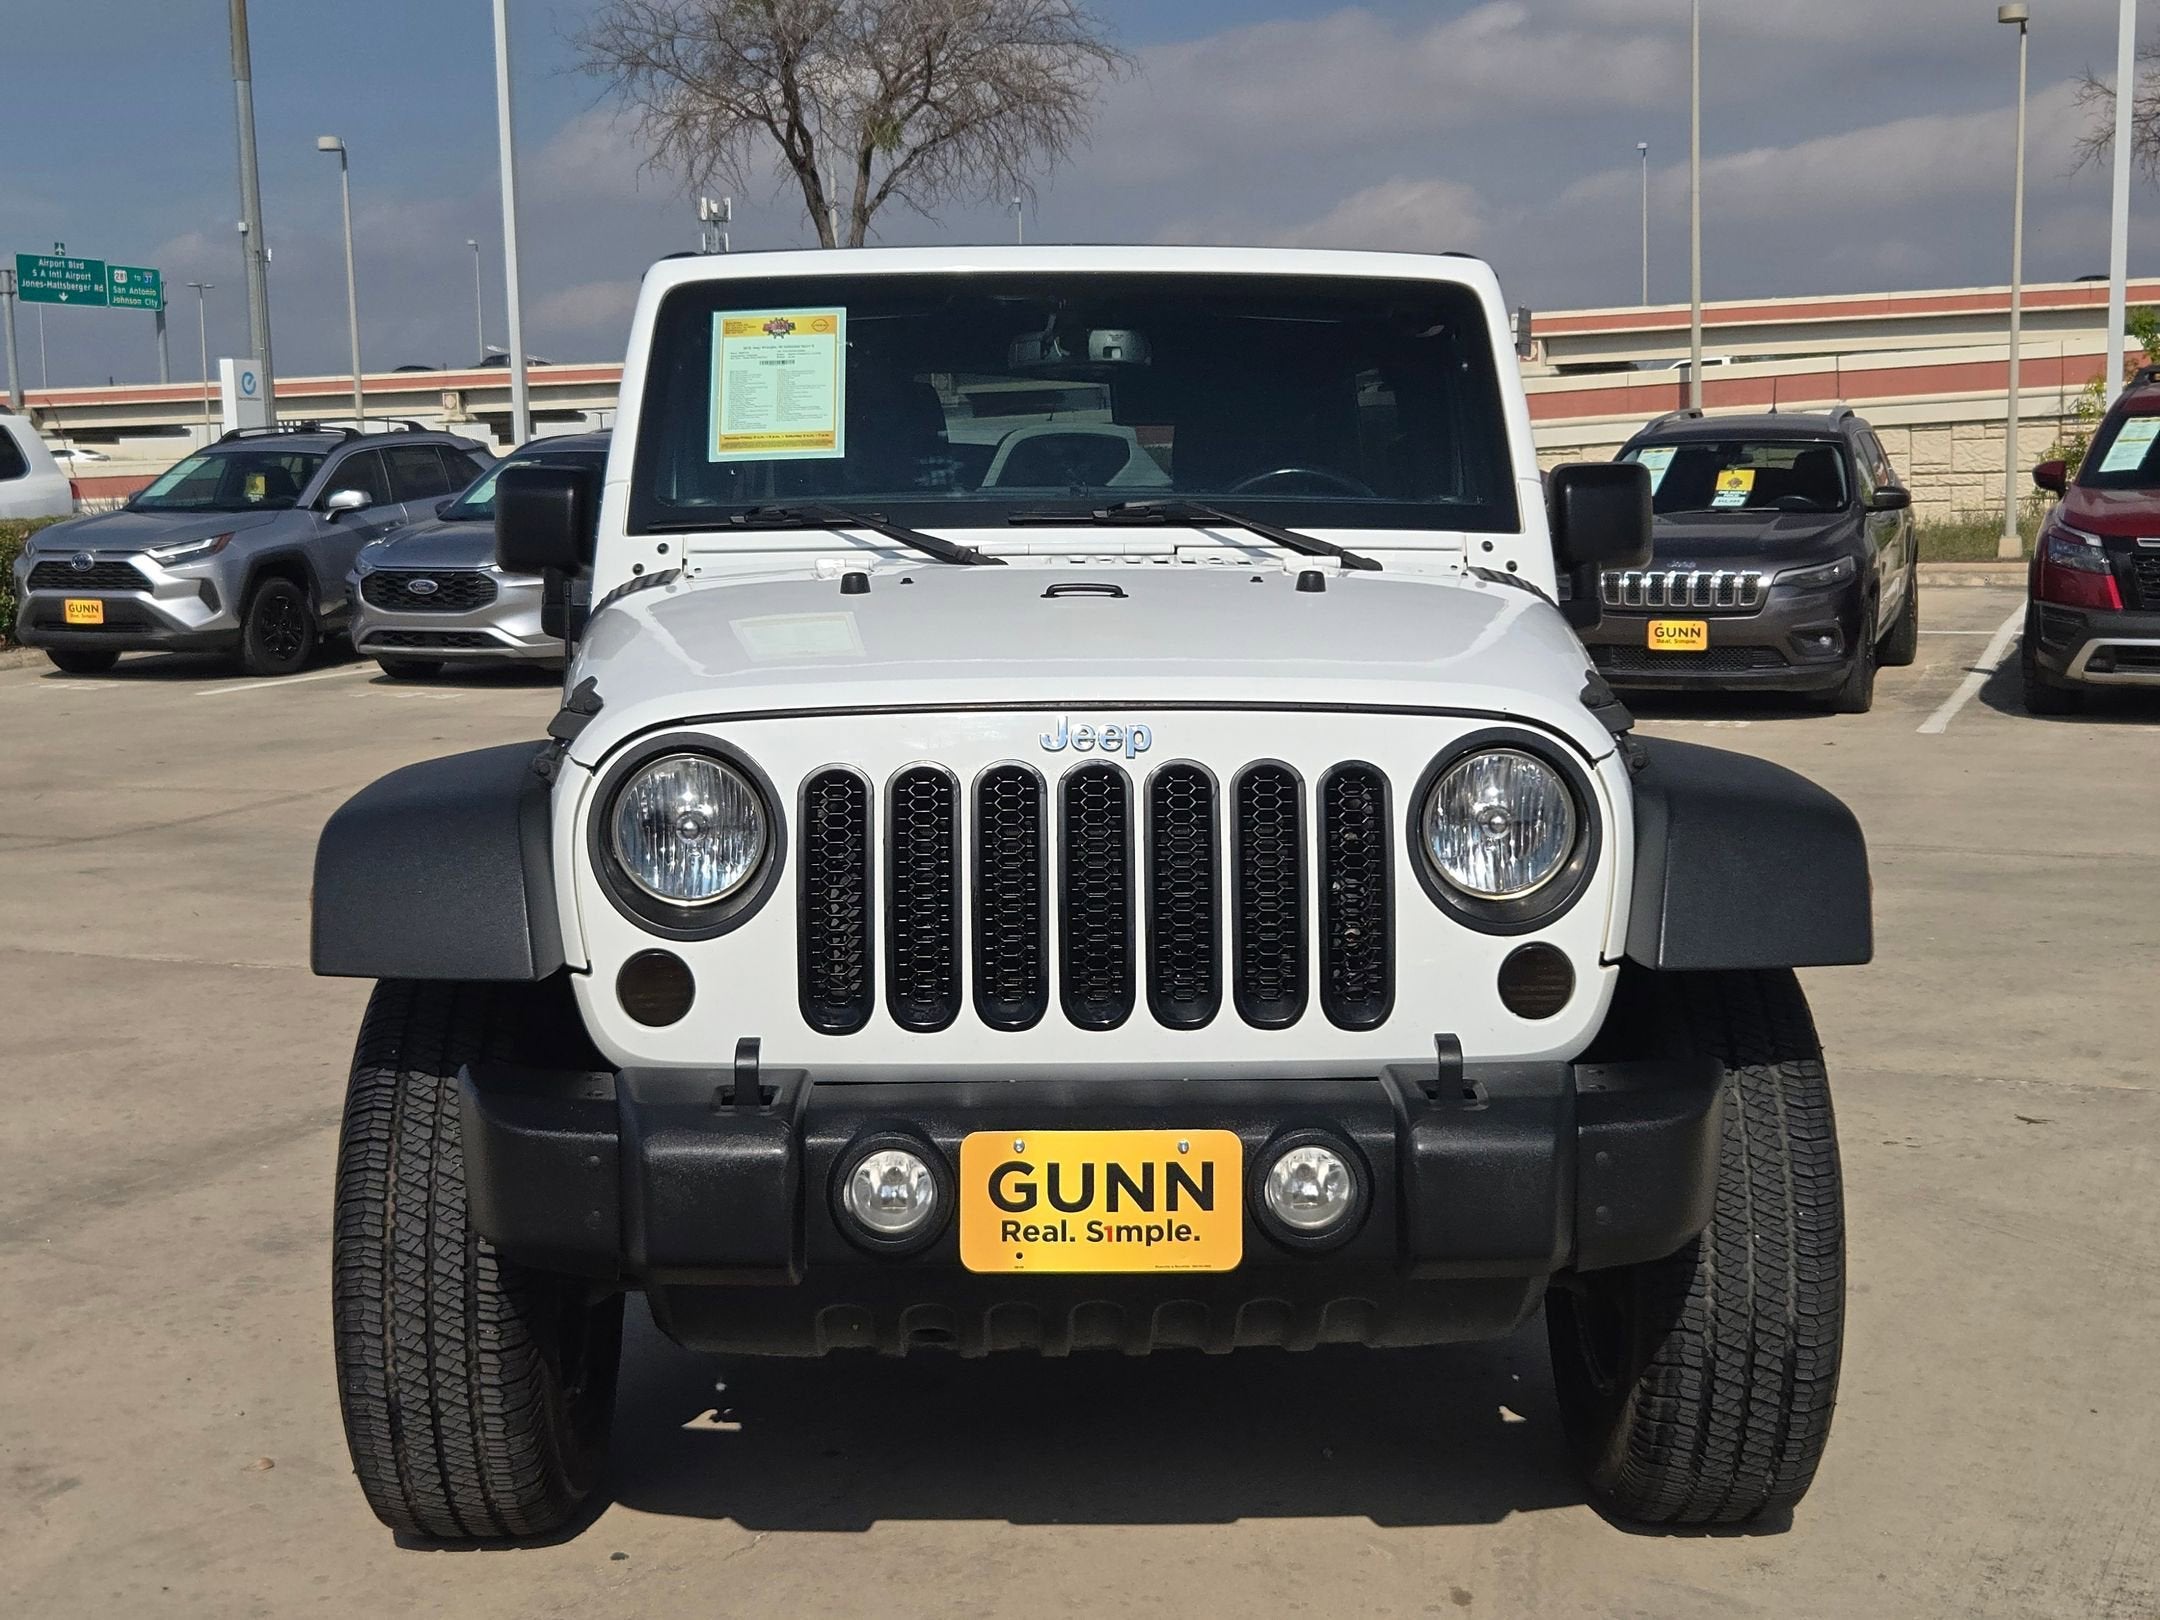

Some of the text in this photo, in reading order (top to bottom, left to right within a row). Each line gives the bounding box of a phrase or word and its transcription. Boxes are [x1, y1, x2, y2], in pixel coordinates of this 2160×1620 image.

[39, 258, 85, 270] Airport Blvd
[32, 269, 38, 277] S
[49, 270, 62, 278] Intl
[65, 271, 91, 281] Airport
[144, 276, 153, 284] 37
[94, 284, 104, 292] Rd
[113, 286, 157, 296] San Antonio
[112, 296, 158, 308] Johnson City
[68, 603, 99, 613] GUNN
[1654, 626, 1701, 638] GUNN
[1040, 714, 1152, 759] Jeep
[988, 1160, 1214, 1213] GUNN
[1001, 1219, 1201, 1247] Real. S1mple.
